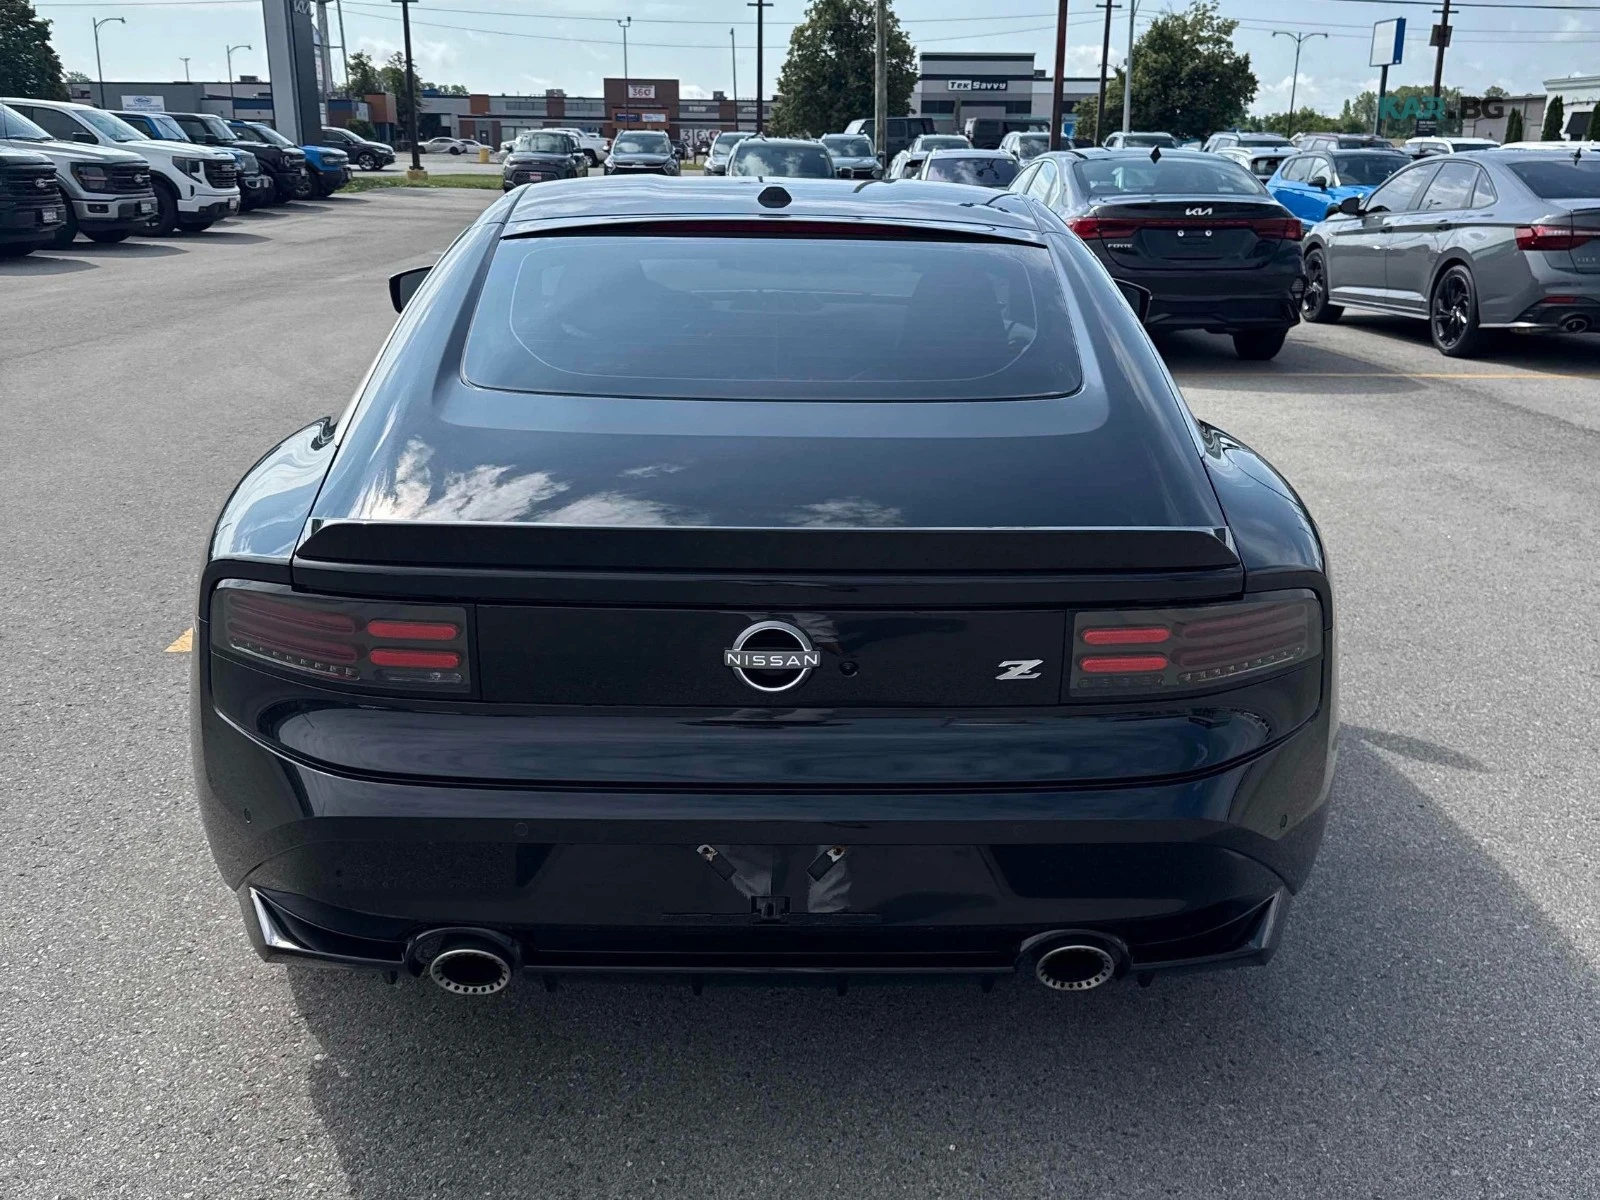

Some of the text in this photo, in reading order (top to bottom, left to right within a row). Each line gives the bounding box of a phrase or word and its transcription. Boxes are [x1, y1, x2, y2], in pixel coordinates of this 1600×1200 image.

[632, 88, 651, 97] 360
[1185, 207, 1213, 216] KIA
[727, 653, 818, 667] NISSAN
[995, 659, 1044, 681] Z
